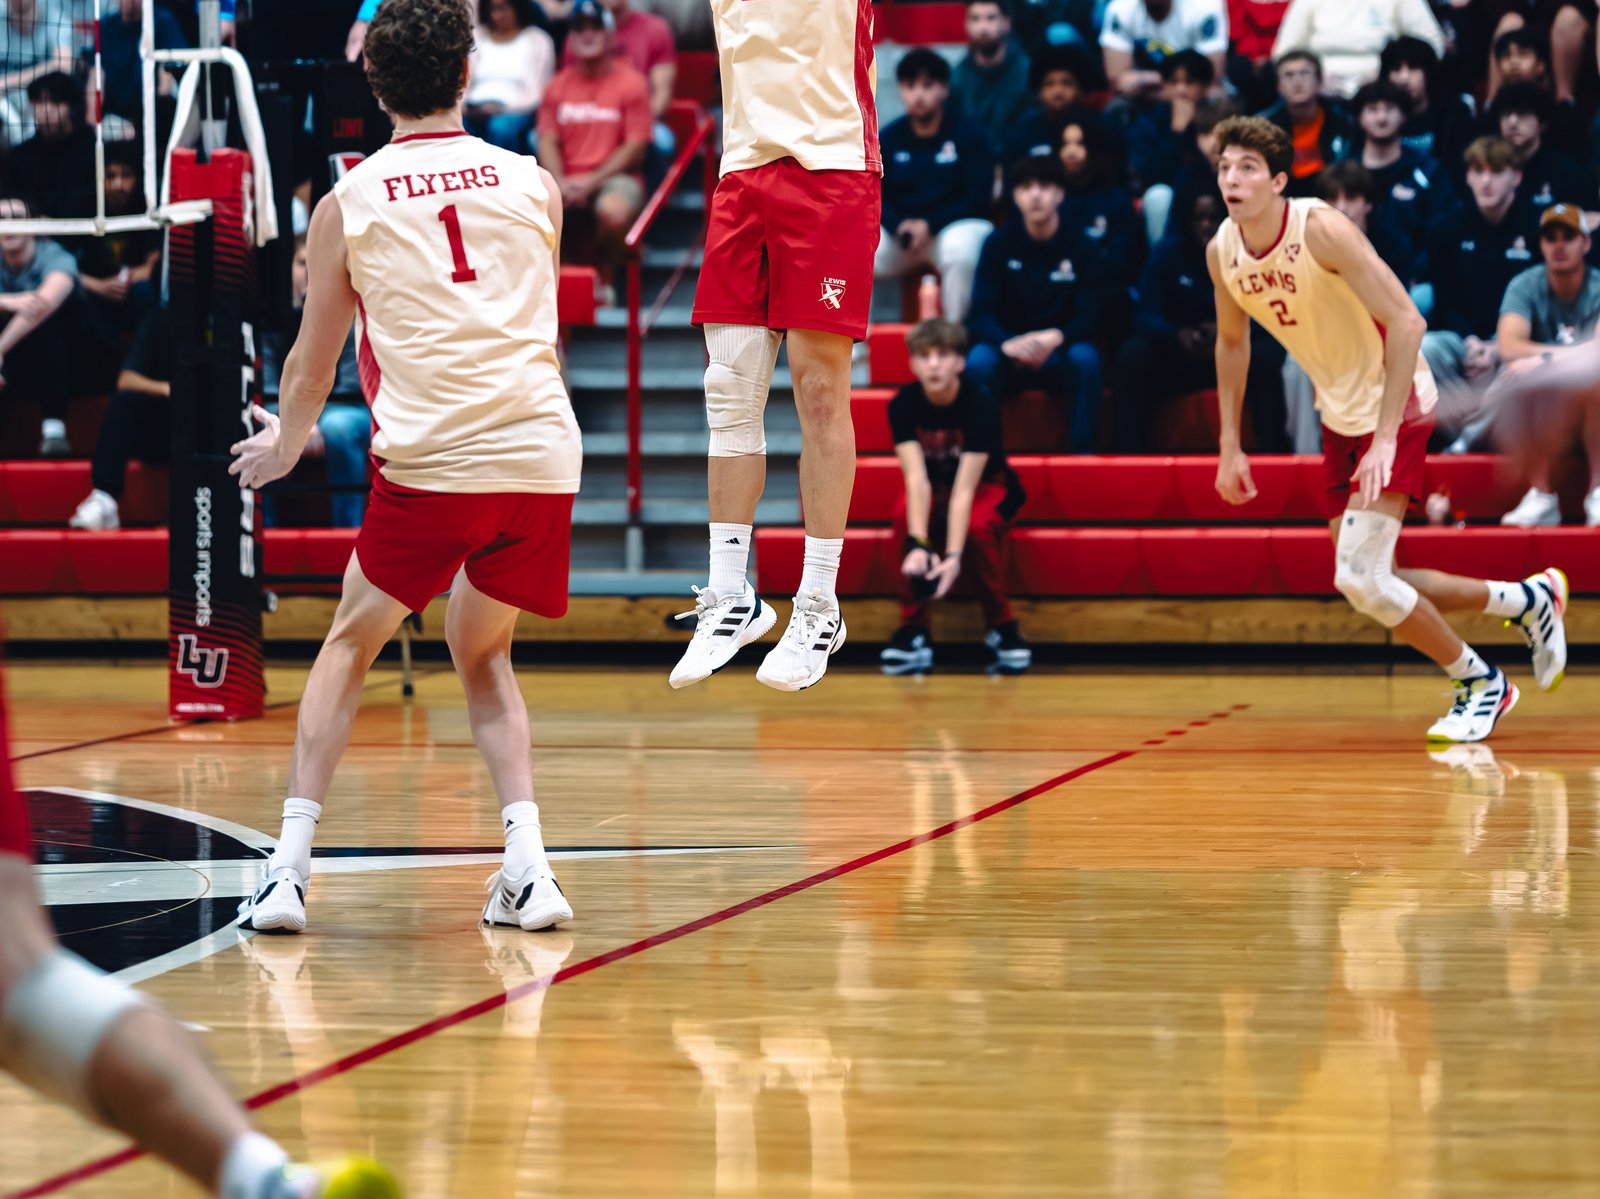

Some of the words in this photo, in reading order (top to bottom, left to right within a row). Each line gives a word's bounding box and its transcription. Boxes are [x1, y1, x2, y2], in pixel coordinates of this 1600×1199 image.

[383, 165, 500, 202] FLYERS
[438, 204, 477, 283] 1
[823, 277, 847, 286] LEWIS
[1238, 269, 1297, 295] LEWIS
[1269, 300, 1297, 326] 2
[241, 321, 255, 577] FLYRS
[194, 486, 212, 549] sports
[194, 550, 212, 626] imports
[176, 634, 229, 689] LU
